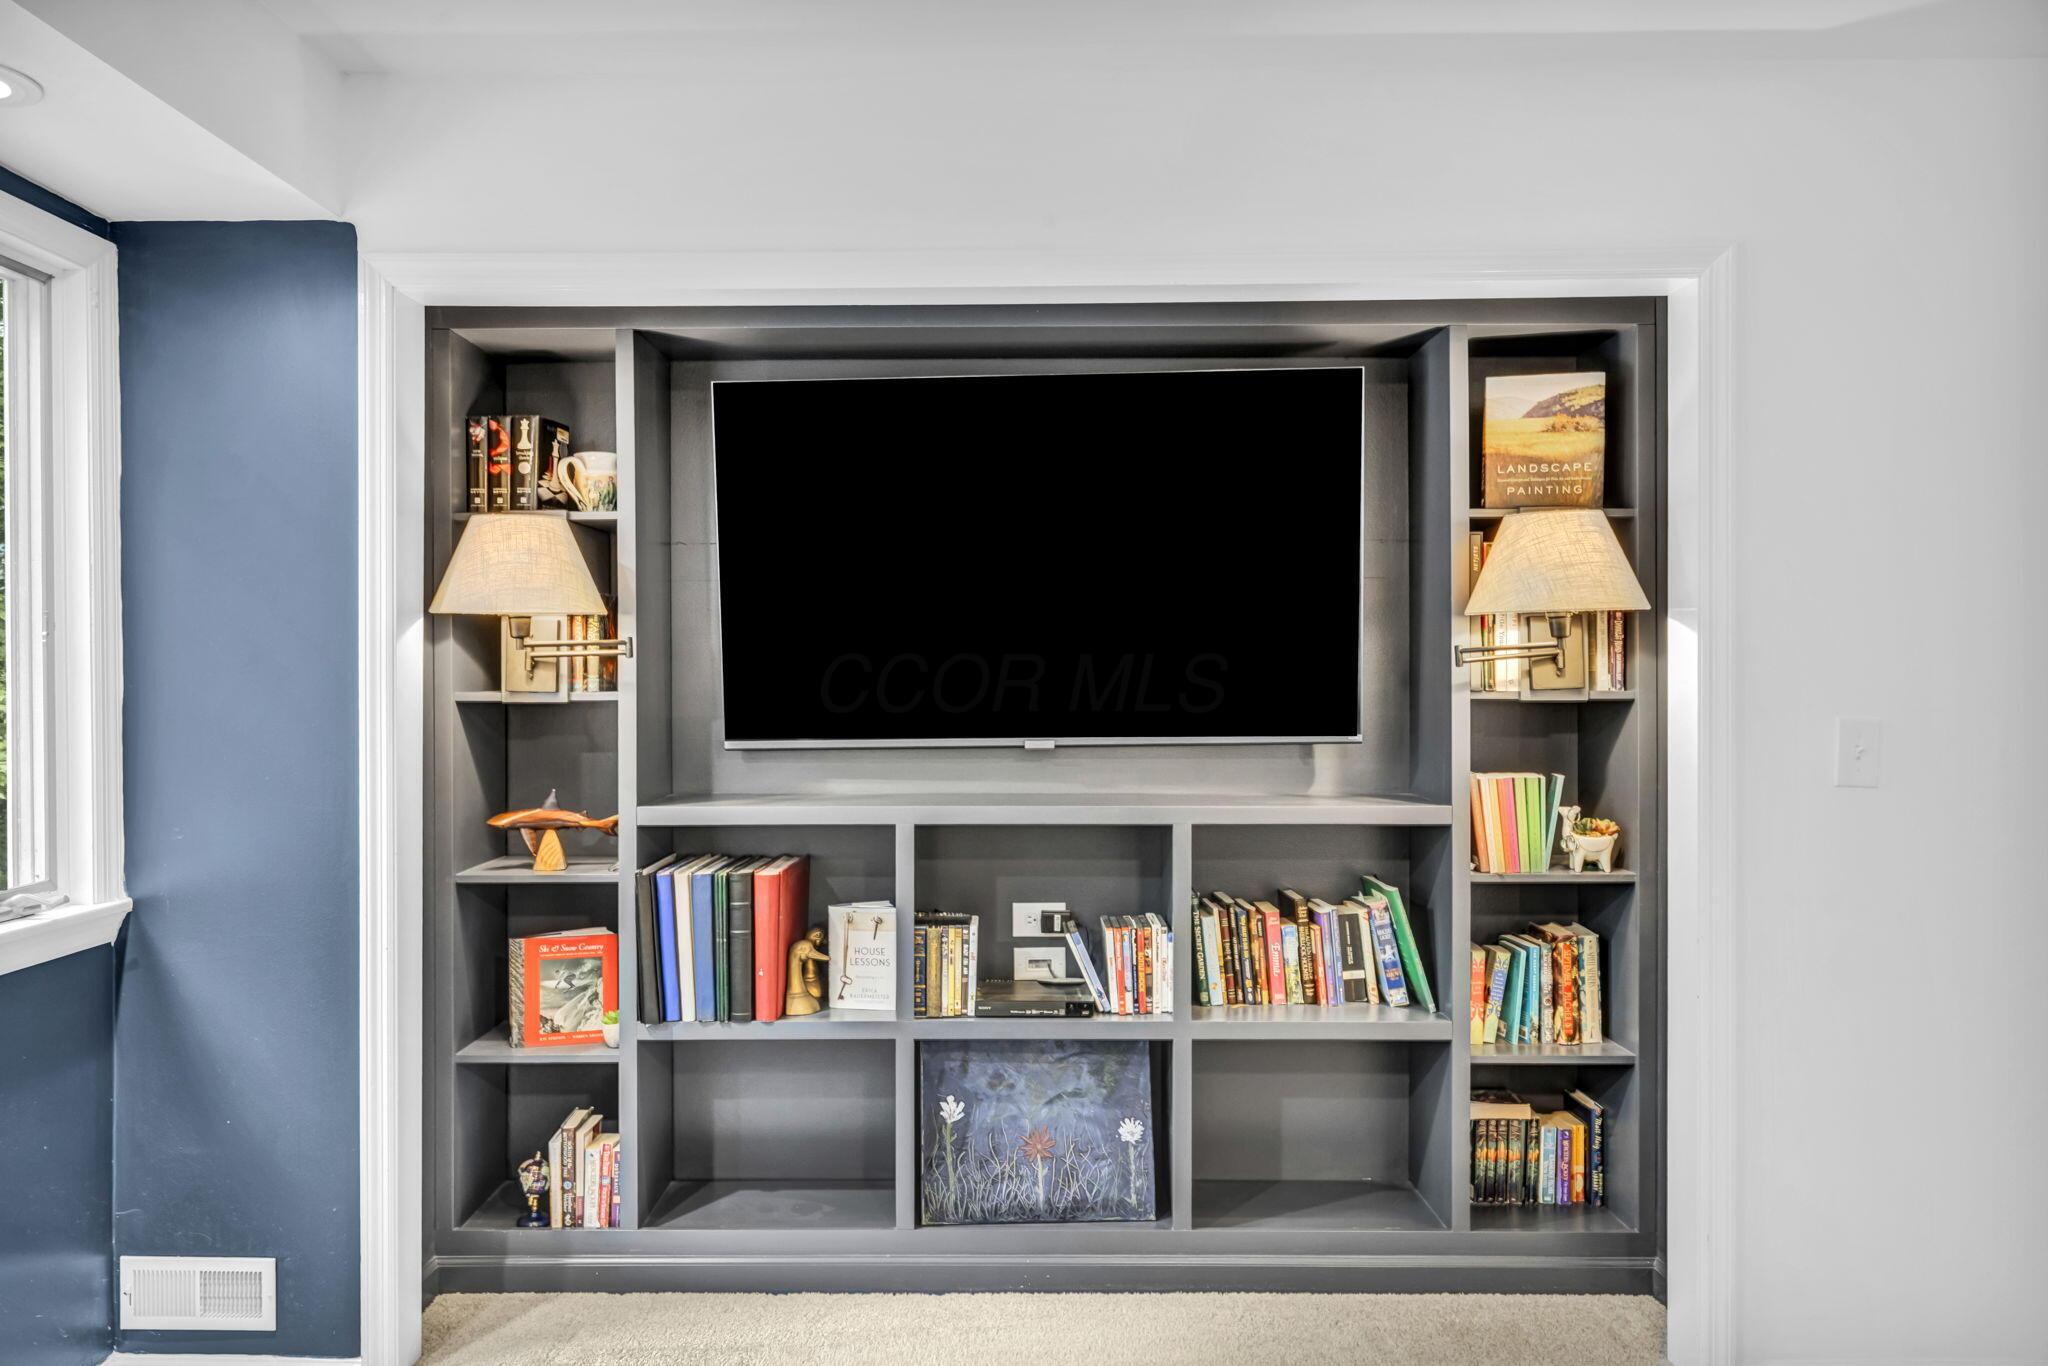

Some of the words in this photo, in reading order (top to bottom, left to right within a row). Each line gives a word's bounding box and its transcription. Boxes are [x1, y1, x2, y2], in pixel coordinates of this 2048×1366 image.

[1497, 462, 1592, 474] LANDSCAPE
[1506, 485, 1583, 495] PAINTING
[1193, 911, 1201, 925] THE
[1194, 927, 1204, 950] SECRET
[854, 947, 886, 956] HOUSE
[850, 958, 891, 967] LESSONS
[1196, 952, 1207, 980] GARDEN
[1271, 942, 1281, 977] Emma
